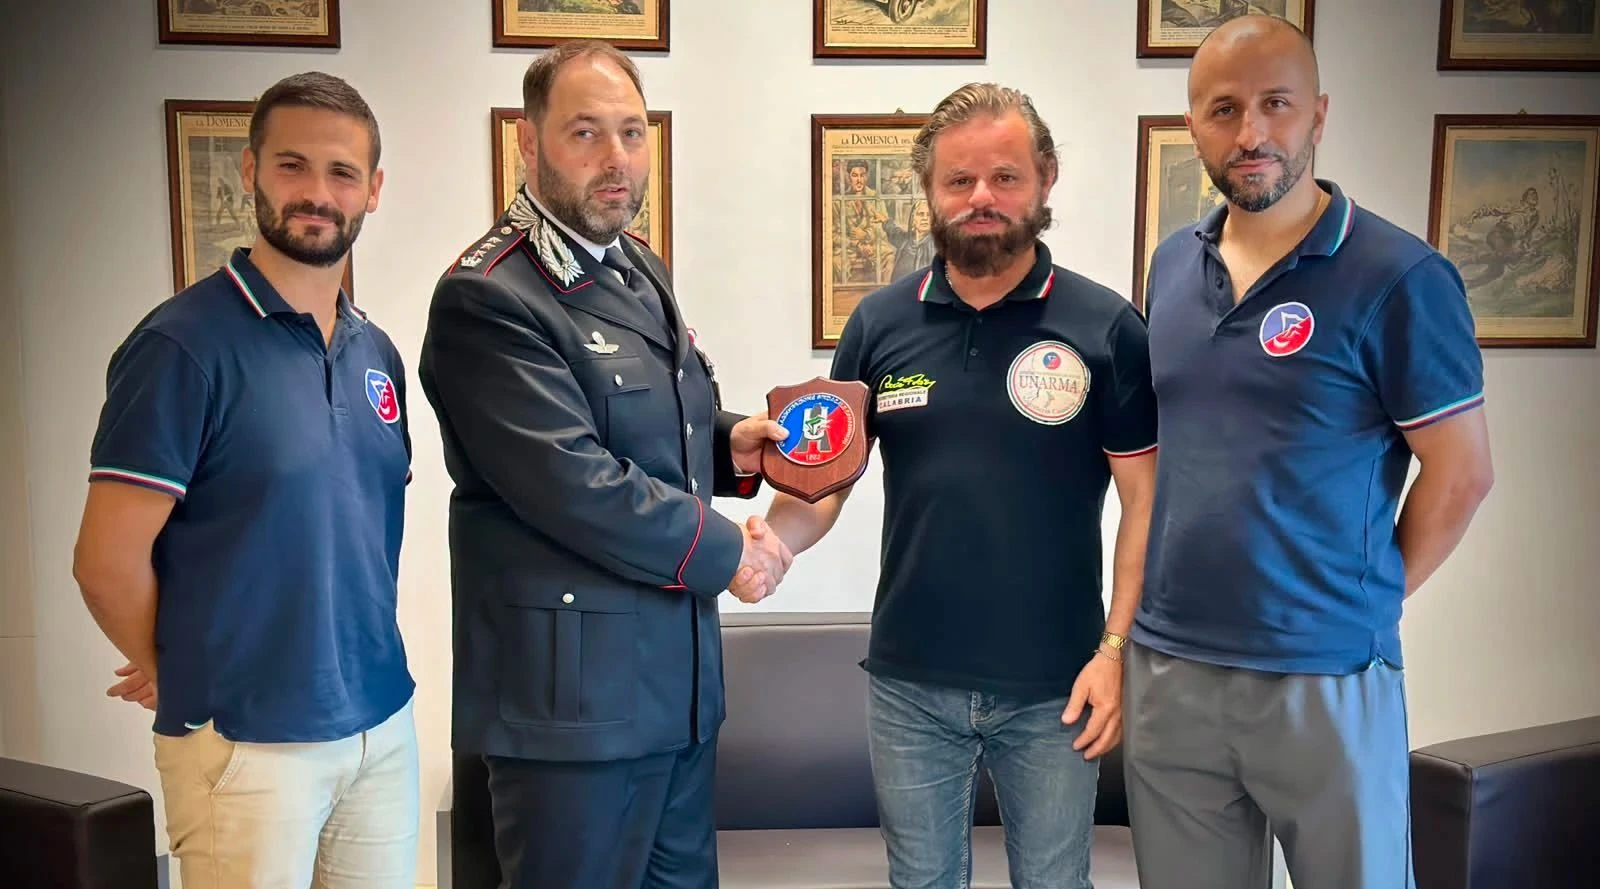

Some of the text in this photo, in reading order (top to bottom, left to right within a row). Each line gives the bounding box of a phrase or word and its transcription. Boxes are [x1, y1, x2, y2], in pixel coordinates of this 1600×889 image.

[206, 115, 250, 128] DOMENIC
[851, 133, 899, 145] DOMENICA
[1018, 375, 1079, 393] UNARMA
[879, 396, 922, 409] CALABRIA
